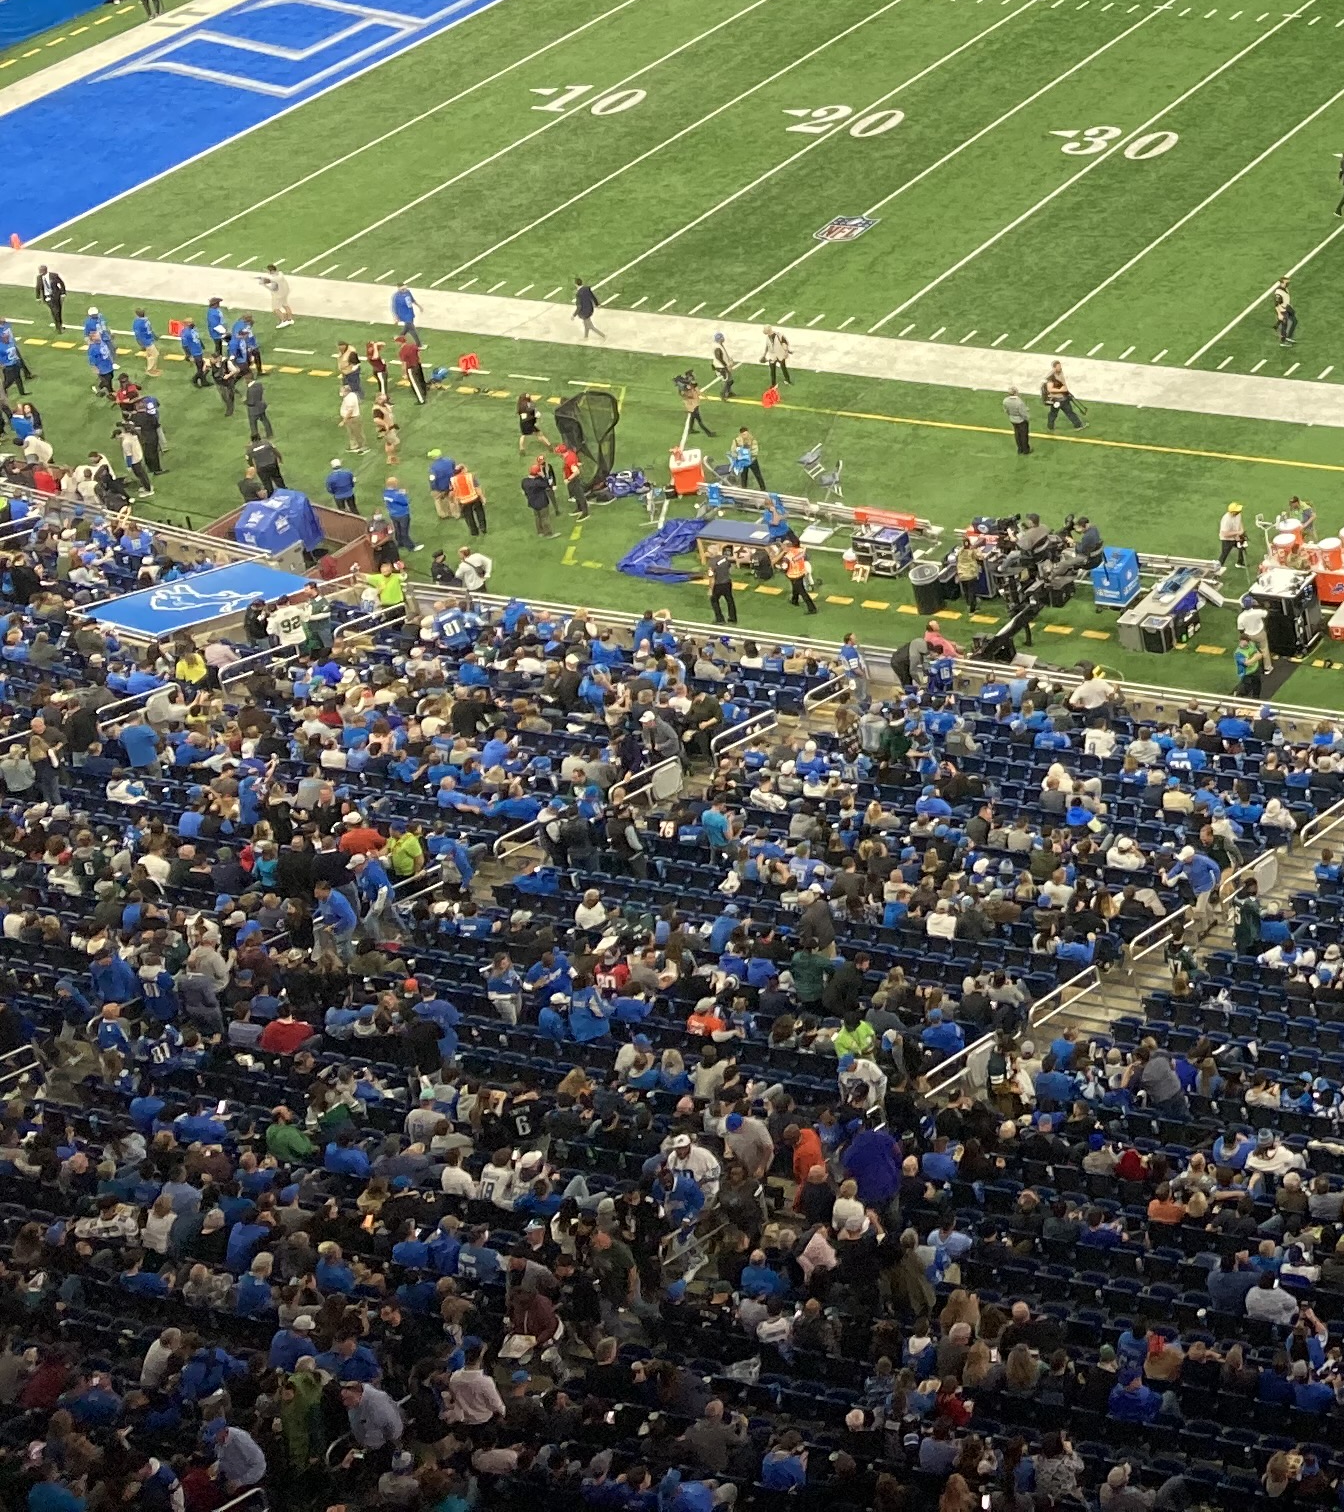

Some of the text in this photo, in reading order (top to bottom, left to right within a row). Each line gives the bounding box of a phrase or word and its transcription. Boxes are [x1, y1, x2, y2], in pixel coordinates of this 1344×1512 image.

[149, 5, 210, 28] IT
[532, 84, 650, 118] 10
[786, 84, 906, 118] 20
[1059, 124, 1180, 160] 30
[461, 354, 478, 370] 20
[278, 615, 302, 634] 92
[659, 820, 676, 838] 76
[516, 1116, 532, 1136] 6
